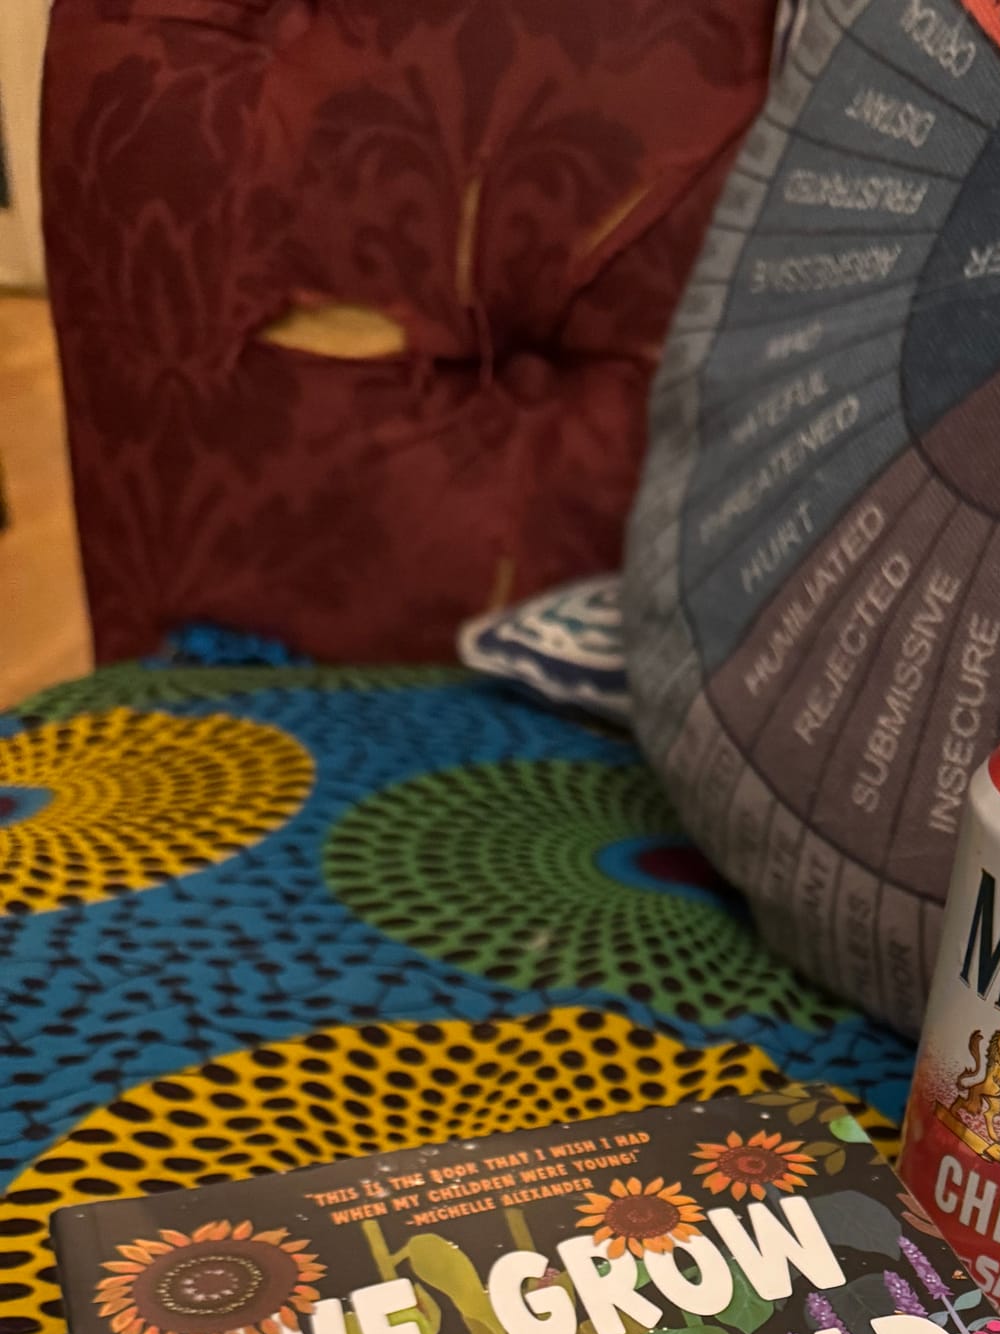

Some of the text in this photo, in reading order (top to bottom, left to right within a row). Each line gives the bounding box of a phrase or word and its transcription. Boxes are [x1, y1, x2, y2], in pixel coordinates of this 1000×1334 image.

[740, 498, 813, 594] HURT
[744, 505, 886, 696] HUMILIATED
[794, 555, 911, 746] REJECTED
[851, 568, 962, 814] SUBMISSIVE
[930, 612, 1000, 834] INSECURE
[330, 1203, 388, 1226] WHEN
[391, 1196, 420, 1213] MY
[426, 1175, 516, 1204] CHILDREN
[519, 1163, 569, 1183] WERE
[362, 1181, 385, 1198] IS
[391, 1174, 425, 1190] THE
[430, 1162, 479, 1183] BOOK
[482, 1152, 529, 1172] THAT
[535, 1149, 547, 1162] I
[549, 1141, 595, 1160] WISH
[599, 1137, 611, 1151] I
[615, 1131, 651, 1147] HAD
[502, 1177, 595, 1208] ALEXANDER
